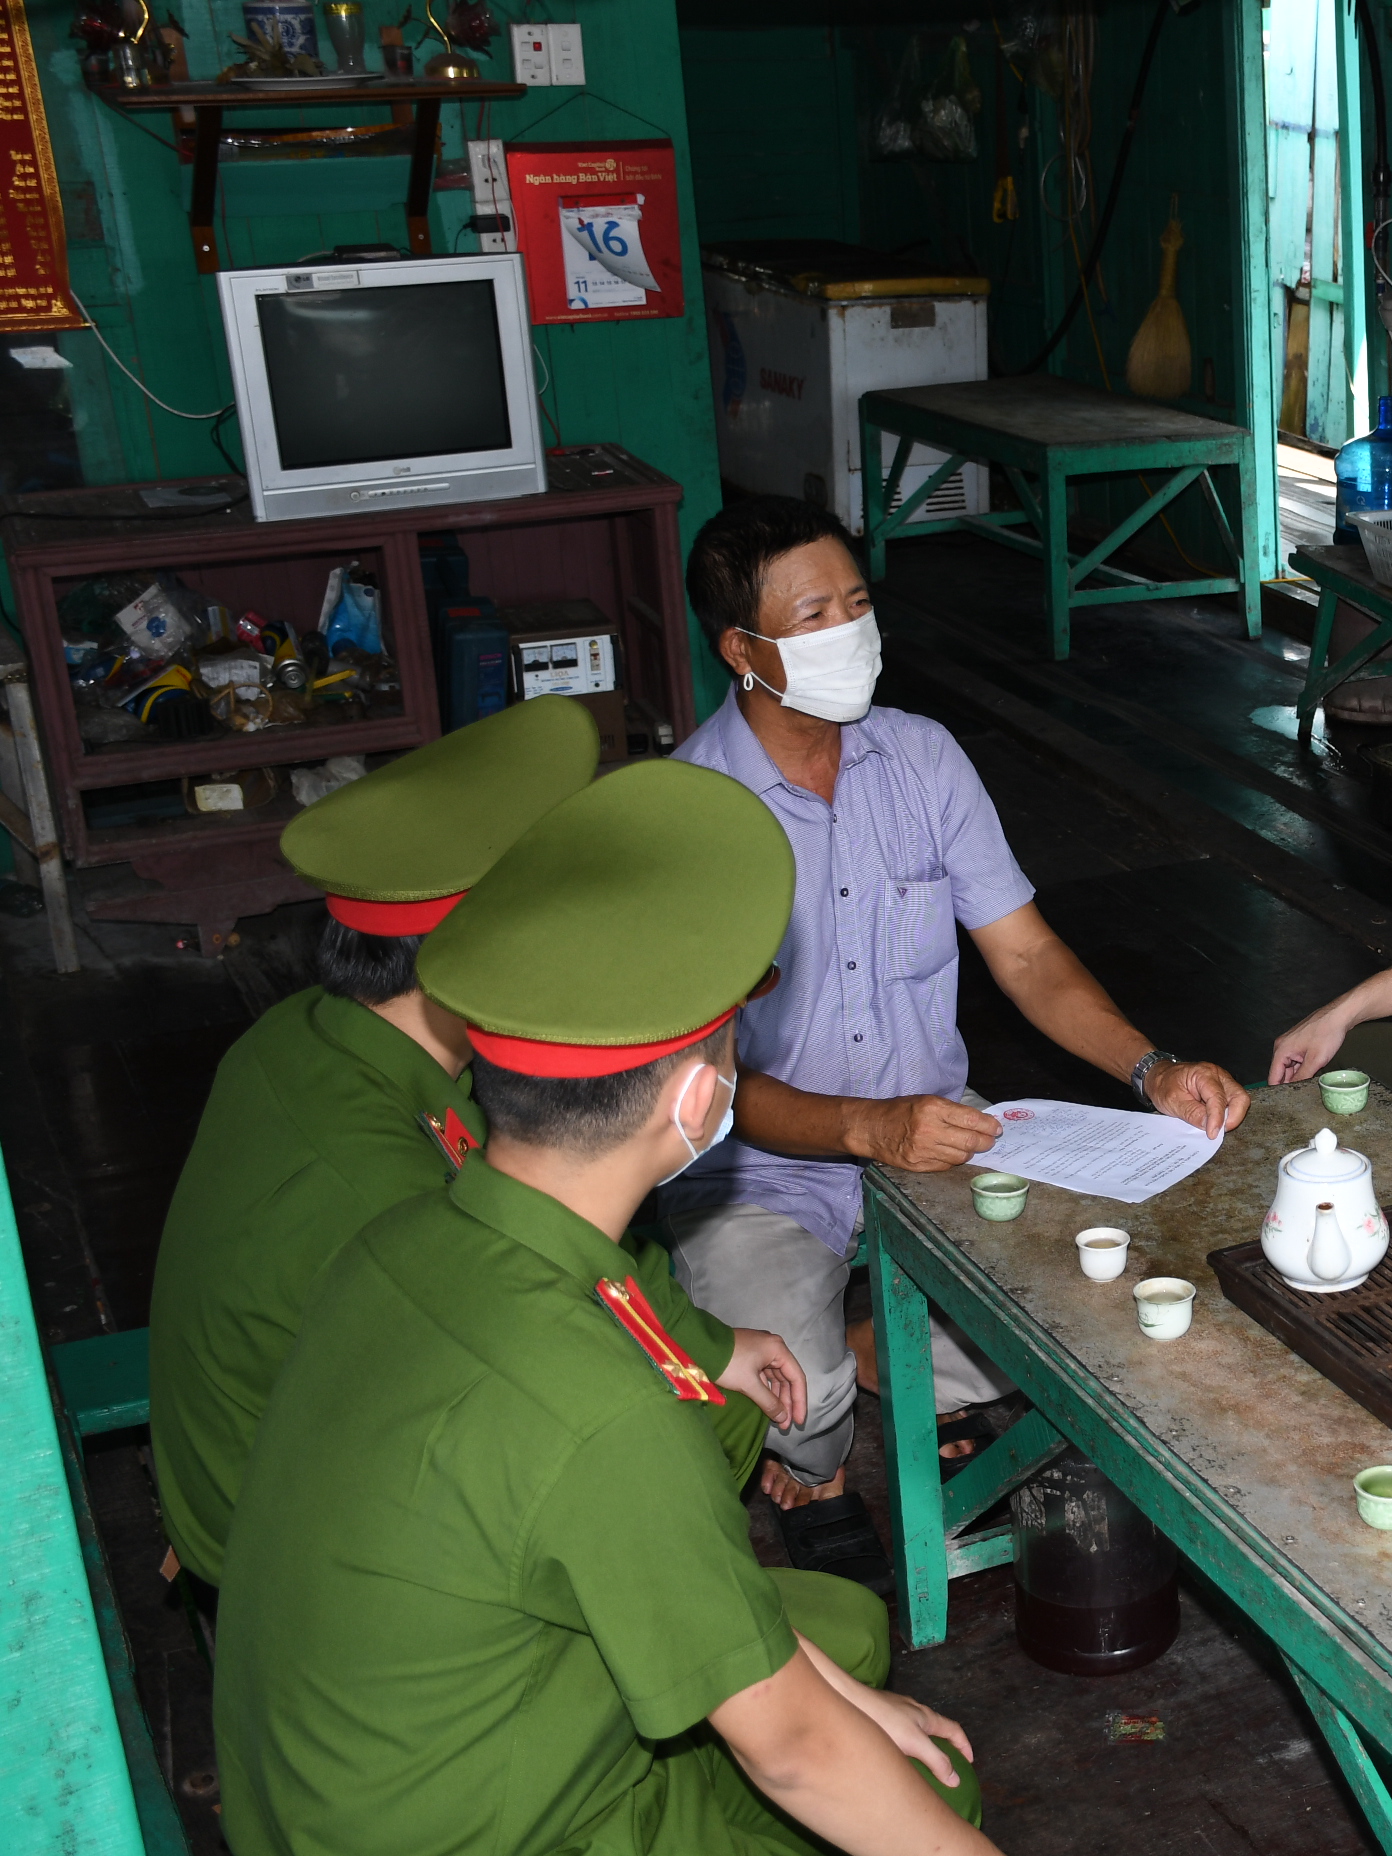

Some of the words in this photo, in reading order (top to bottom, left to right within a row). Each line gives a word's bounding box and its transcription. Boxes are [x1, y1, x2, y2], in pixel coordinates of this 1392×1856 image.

[525, 173, 552, 185] Ngân
[552, 173, 578, 184] hàng
[598, 172, 618, 183] Việt
[577, 220, 629, 257] 16
[574, 280, 589, 294] 11
[760, 368, 805, 400] SANAKY
